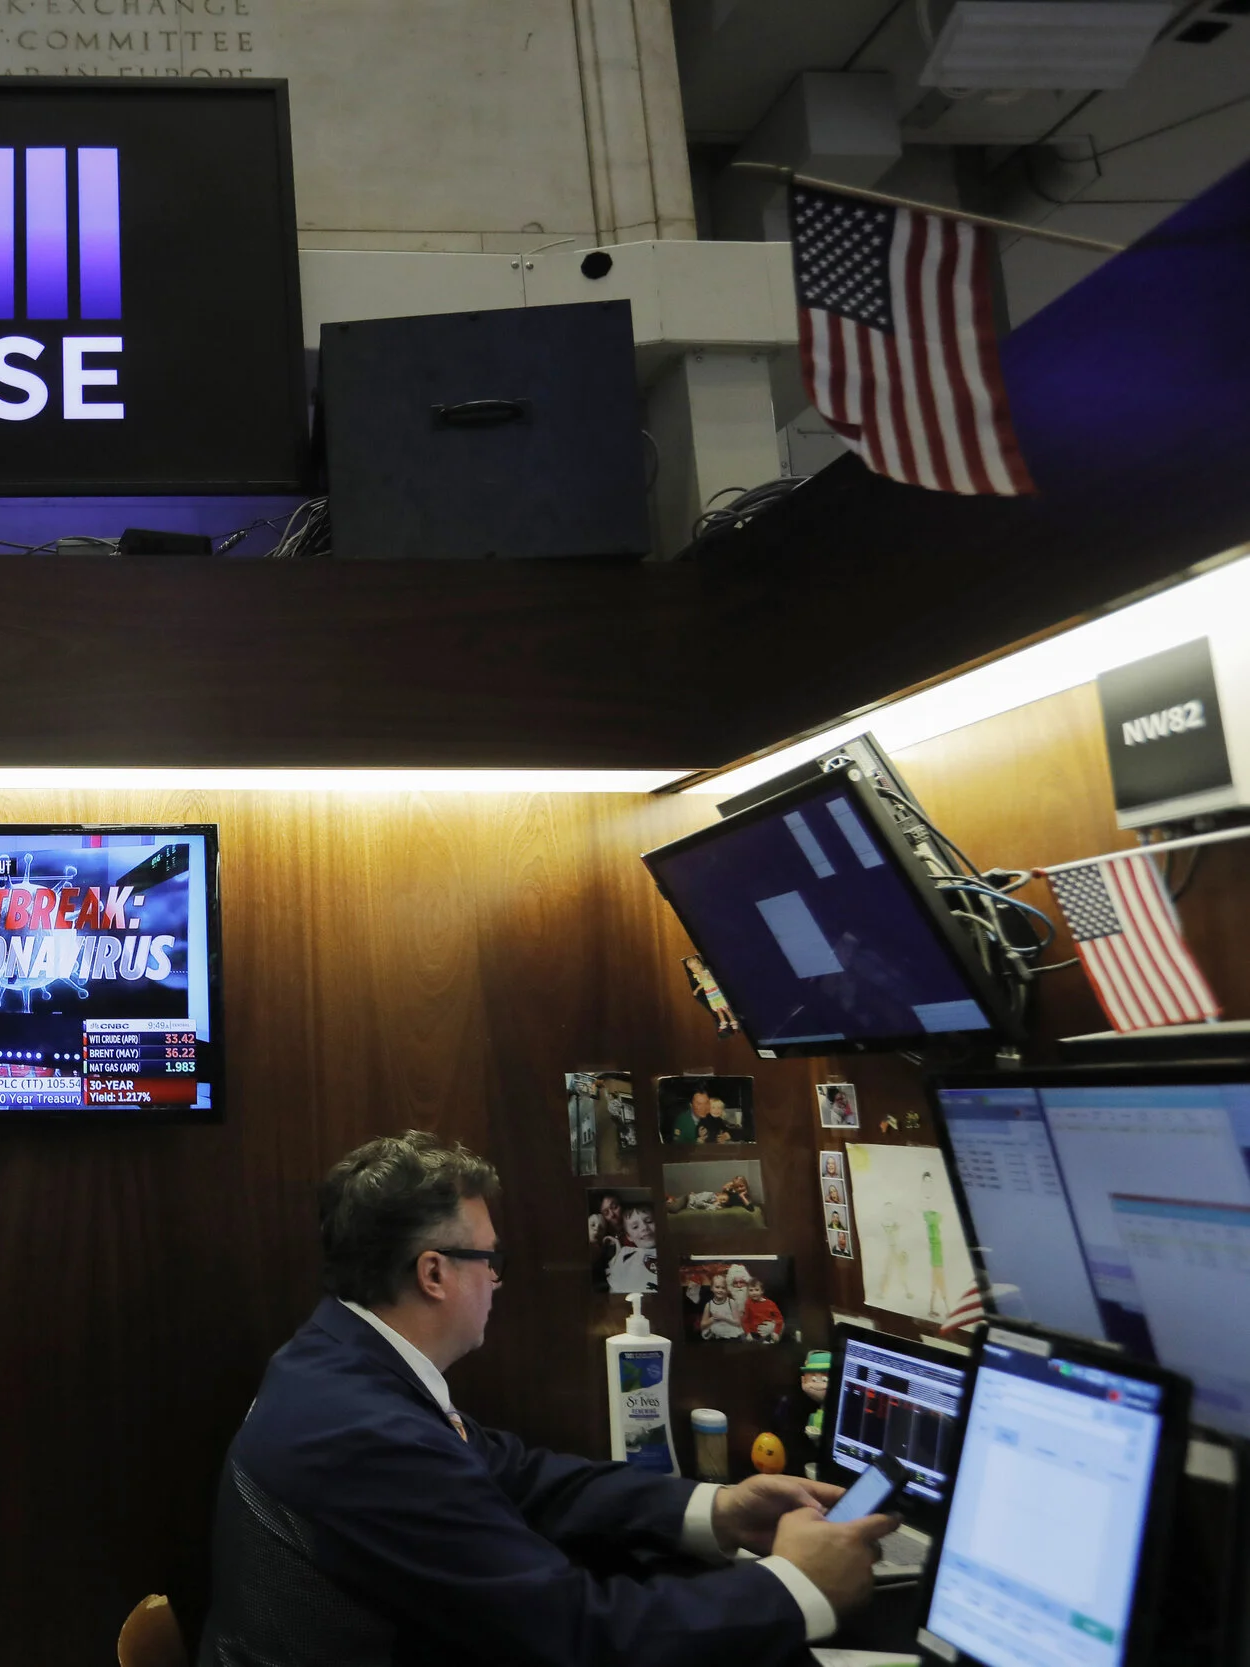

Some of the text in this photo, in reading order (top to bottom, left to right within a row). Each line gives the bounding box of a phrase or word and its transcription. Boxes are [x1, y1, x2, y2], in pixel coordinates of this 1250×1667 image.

[47, 0, 250, 17] EXCHANGE
[17, 29, 253, 53] COMMITTEE
[1122, 699, 1206, 747] NW82
[101, 1034, 121, 1044] CRUDE
[122, 1034, 139, 1044] (APR)
[165, 1034, 195, 1044] 33.42
[90, 1049, 139, 1058] BRENT (MAY)
[165, 1048, 195, 1058] 36.22
[90, 1063, 139, 1073] NAT GAS (APR)
[165, 1062, 195, 1072] 1.983
[21, 1079, 43, 1090] (TT)
[47, 1079, 81, 1089] 105.54
[90, 1081, 134, 1091] 30-YEAR
[9, 1094, 33, 1104] Year
[37, 1094, 81, 1106] Treasury
[90, 1092, 151, 1102] Yield: 1.217%
